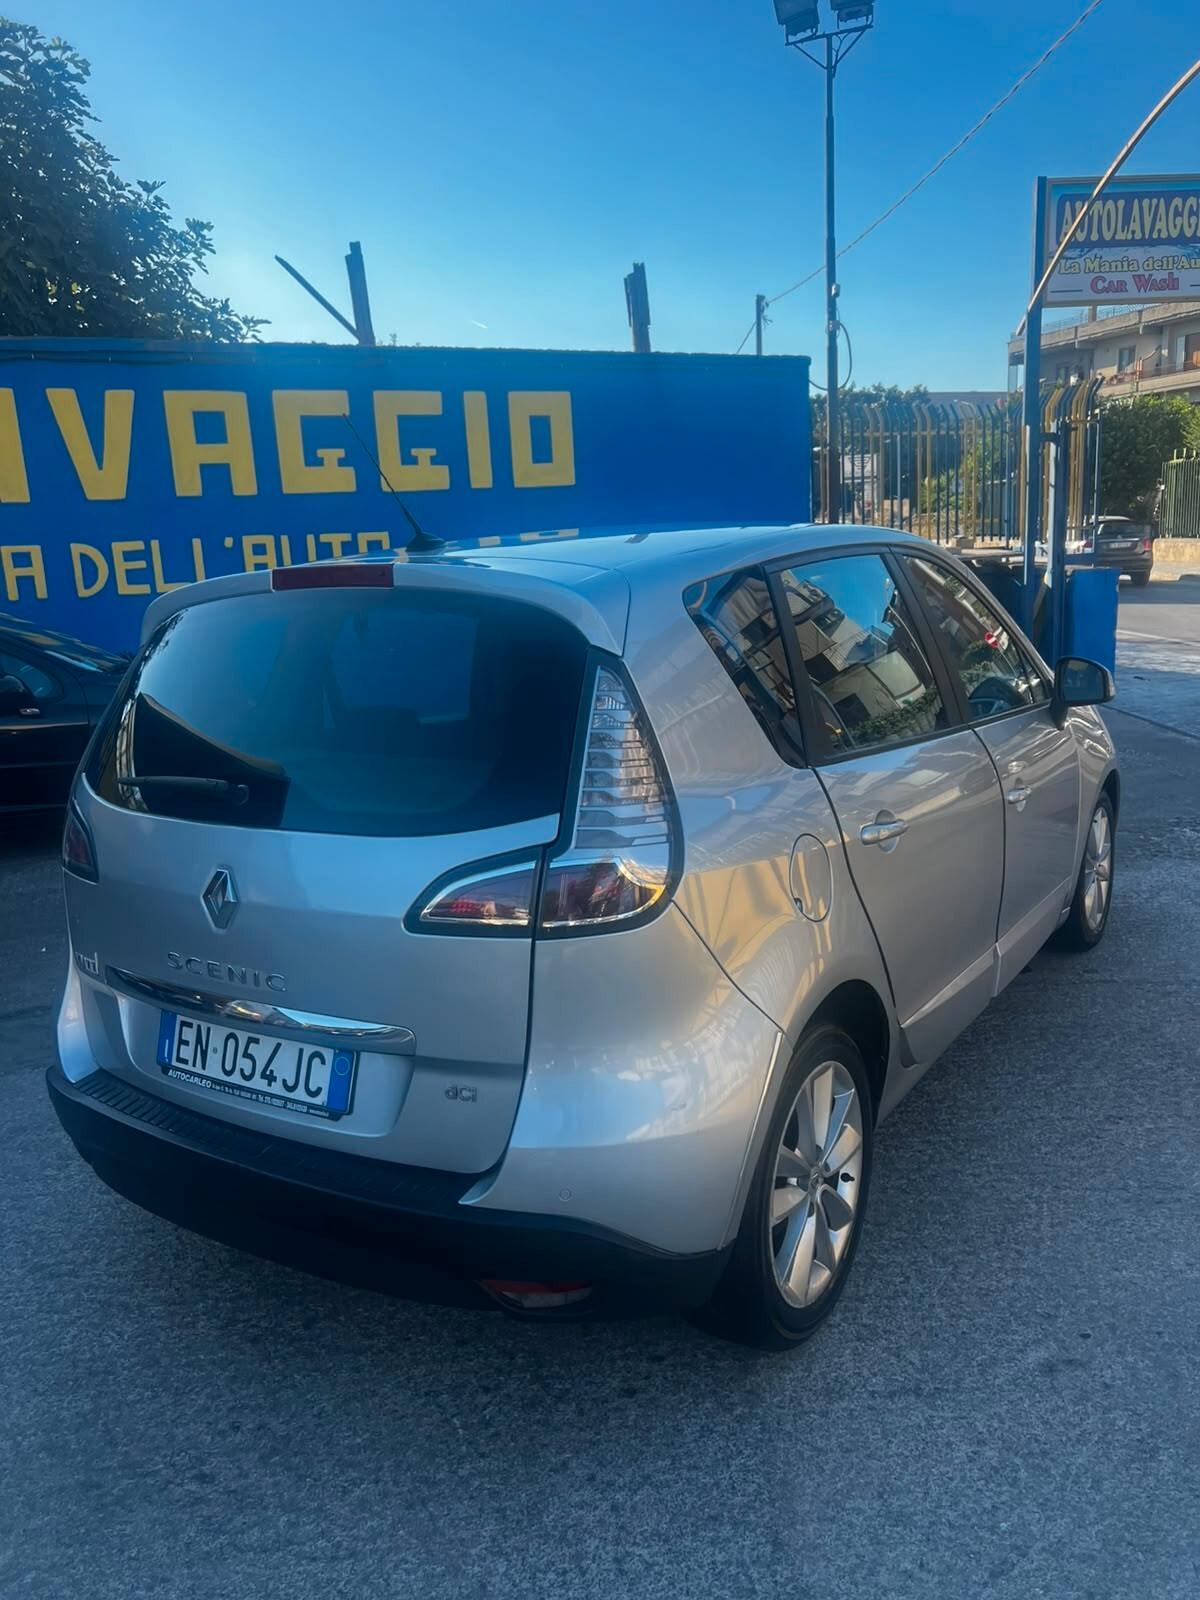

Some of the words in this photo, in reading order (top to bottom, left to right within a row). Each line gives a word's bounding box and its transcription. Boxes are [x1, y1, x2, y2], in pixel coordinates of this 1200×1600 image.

[1060, 259, 1080, 274] La
[1085, 256, 1138, 273] Mania
[167, 951, 288, 992] SCENIC
[175, 1020, 211, 1071] EN
[168, 1069, 212, 1089] AUTOCARLEO
